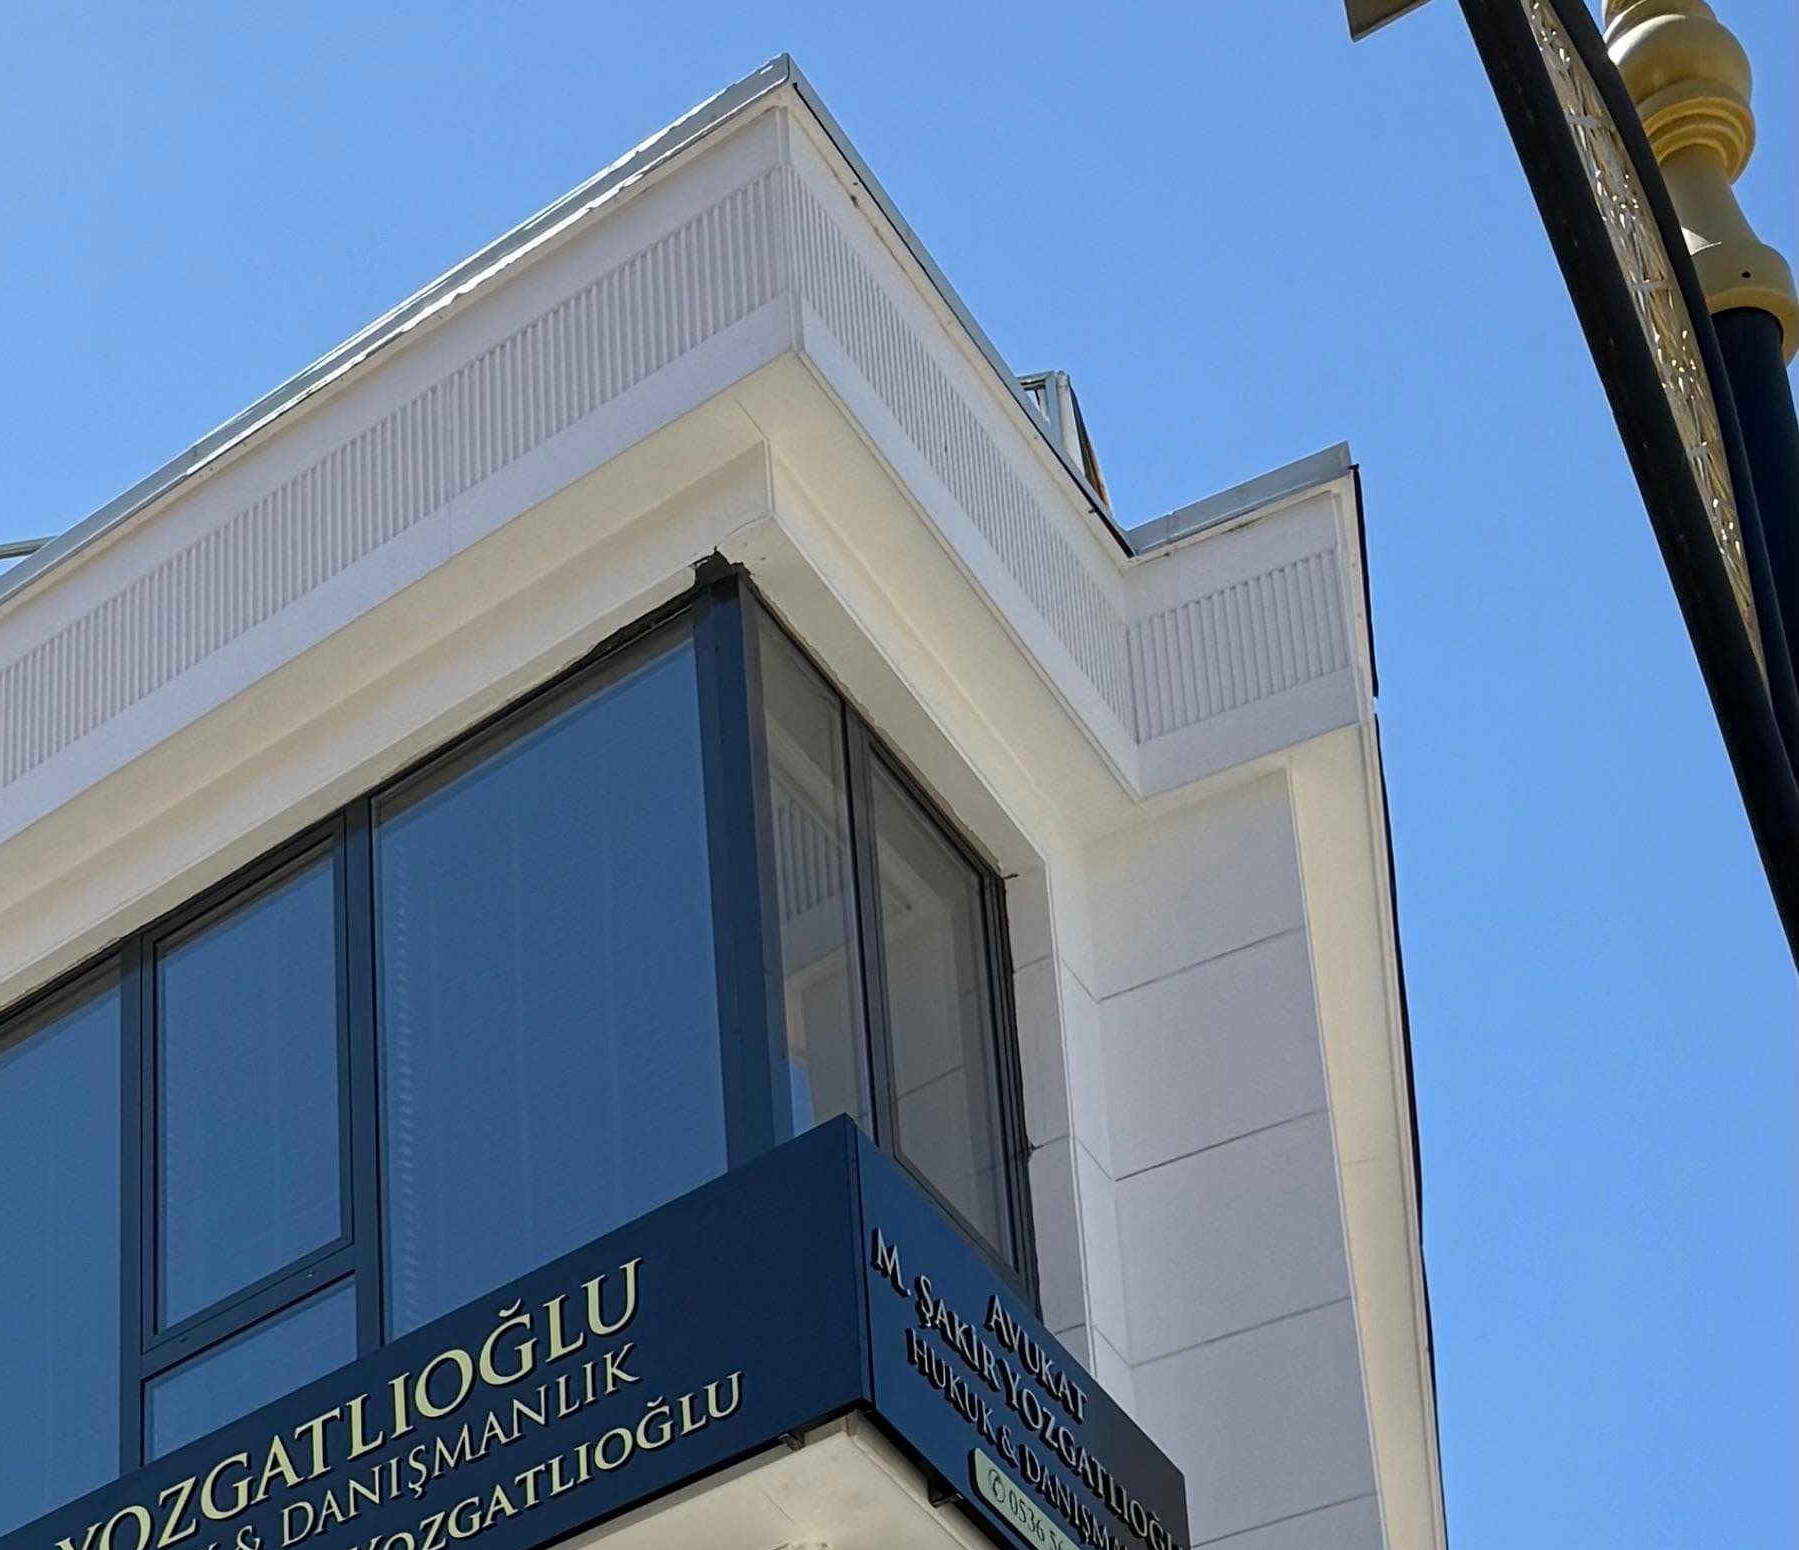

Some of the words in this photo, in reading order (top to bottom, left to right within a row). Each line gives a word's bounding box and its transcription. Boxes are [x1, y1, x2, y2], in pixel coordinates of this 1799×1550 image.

[873, 1227, 911, 1296] M.
[916, 1275, 1001, 1391] ŞAKİR
[986, 1294, 1086, 1423] AVUKAT
[281, 1342, 641, 1548] DANIŞMANLIK
[908, 1328, 997, 1444] HUKUK
[1000, 1425, 1018, 1467] &
[1009, 1490, 1045, 1542] 0536
